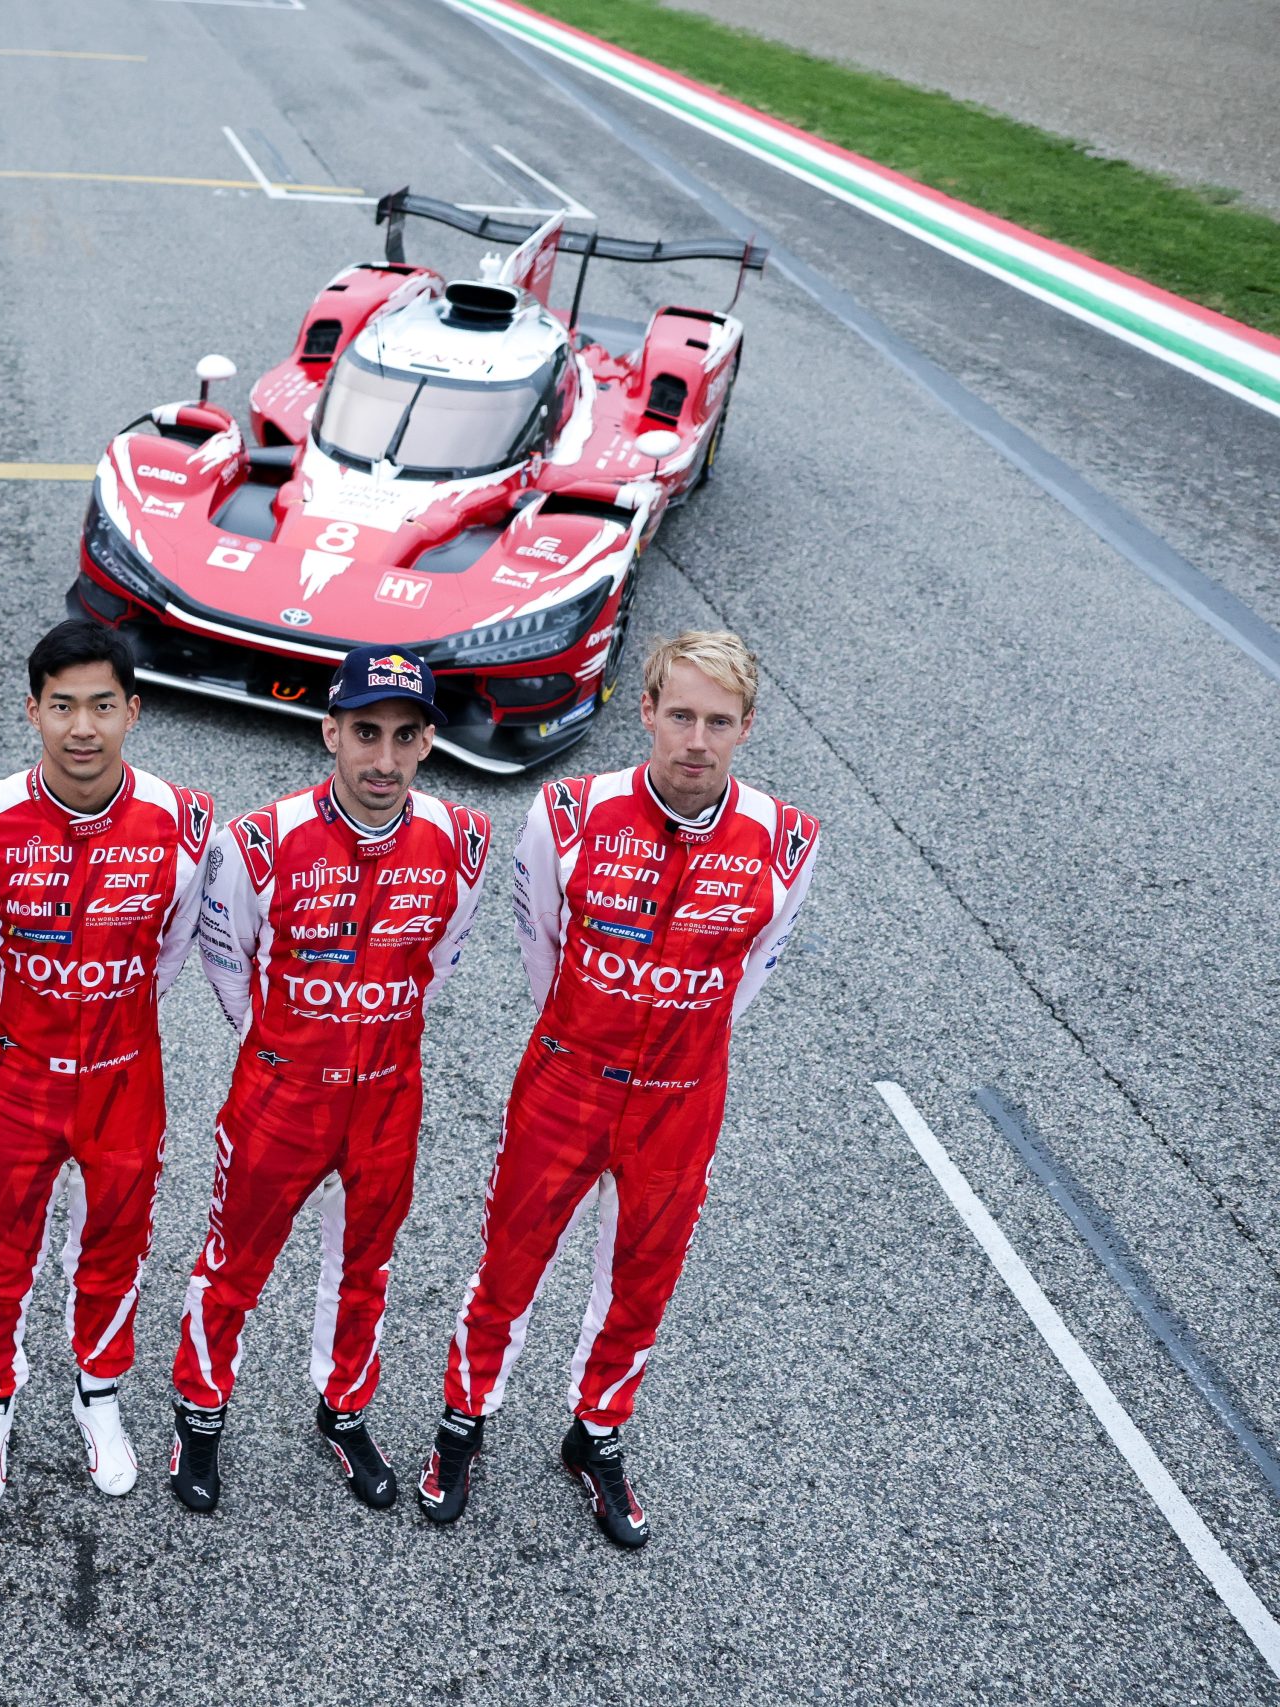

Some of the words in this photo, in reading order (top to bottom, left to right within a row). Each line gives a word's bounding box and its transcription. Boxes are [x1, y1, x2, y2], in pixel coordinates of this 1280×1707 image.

[137, 465, 188, 485] CASIO
[315, 521, 360, 553] 8
[516, 546, 569, 565] EDIFICE
[379, 576, 427, 602] HY
[368, 673, 397, 687] Red
[398, 674, 423, 694] Bull
[73, 817, 113, 832] TOYOTA
[360, 838, 397, 852] TOYOTA
[594, 826, 666, 862] FUJITSU
[680, 832, 715, 842] TOYO
[6, 835, 72, 868] FUJITSU
[89, 846, 165, 864] DENSO
[8, 872, 70, 887] AISIN
[104, 873, 150, 888] ZENT
[291, 857, 360, 893] FUJITSU
[377, 867, 446, 885] DENSO
[593, 862, 661, 885] AISIN
[695, 879, 744, 898] ZENT
[6, 900, 51, 917] Mobil
[85, 893, 162, 914] WEC
[293, 893, 357, 912] AISIN
[389, 894, 433, 910] ZENT
[586, 890, 638, 913] Mobil
[674, 902, 756, 925] WEC
[290, 922, 338, 940] Mobil
[371, 915, 443, 935] WEC
[601, 925, 647, 939] MICHELIN
[707, 924, 744, 933] ENDURANCE
[24, 932, 66, 940] MICHELIN
[307, 952, 350, 960] MICHELIN
[8, 947, 146, 988] TOYOTA
[579, 938, 724, 994] TOYOTA
[283, 974, 419, 1010] TOYOTA
[581, 972, 716, 1010] RACING
[287, 1005, 414, 1024] RACING
[91, 1050, 139, 1070] HIRAKAWA
[369, 1064, 397, 1080] BUEMI
[644, 1078, 700, 1089] HARTLEY
